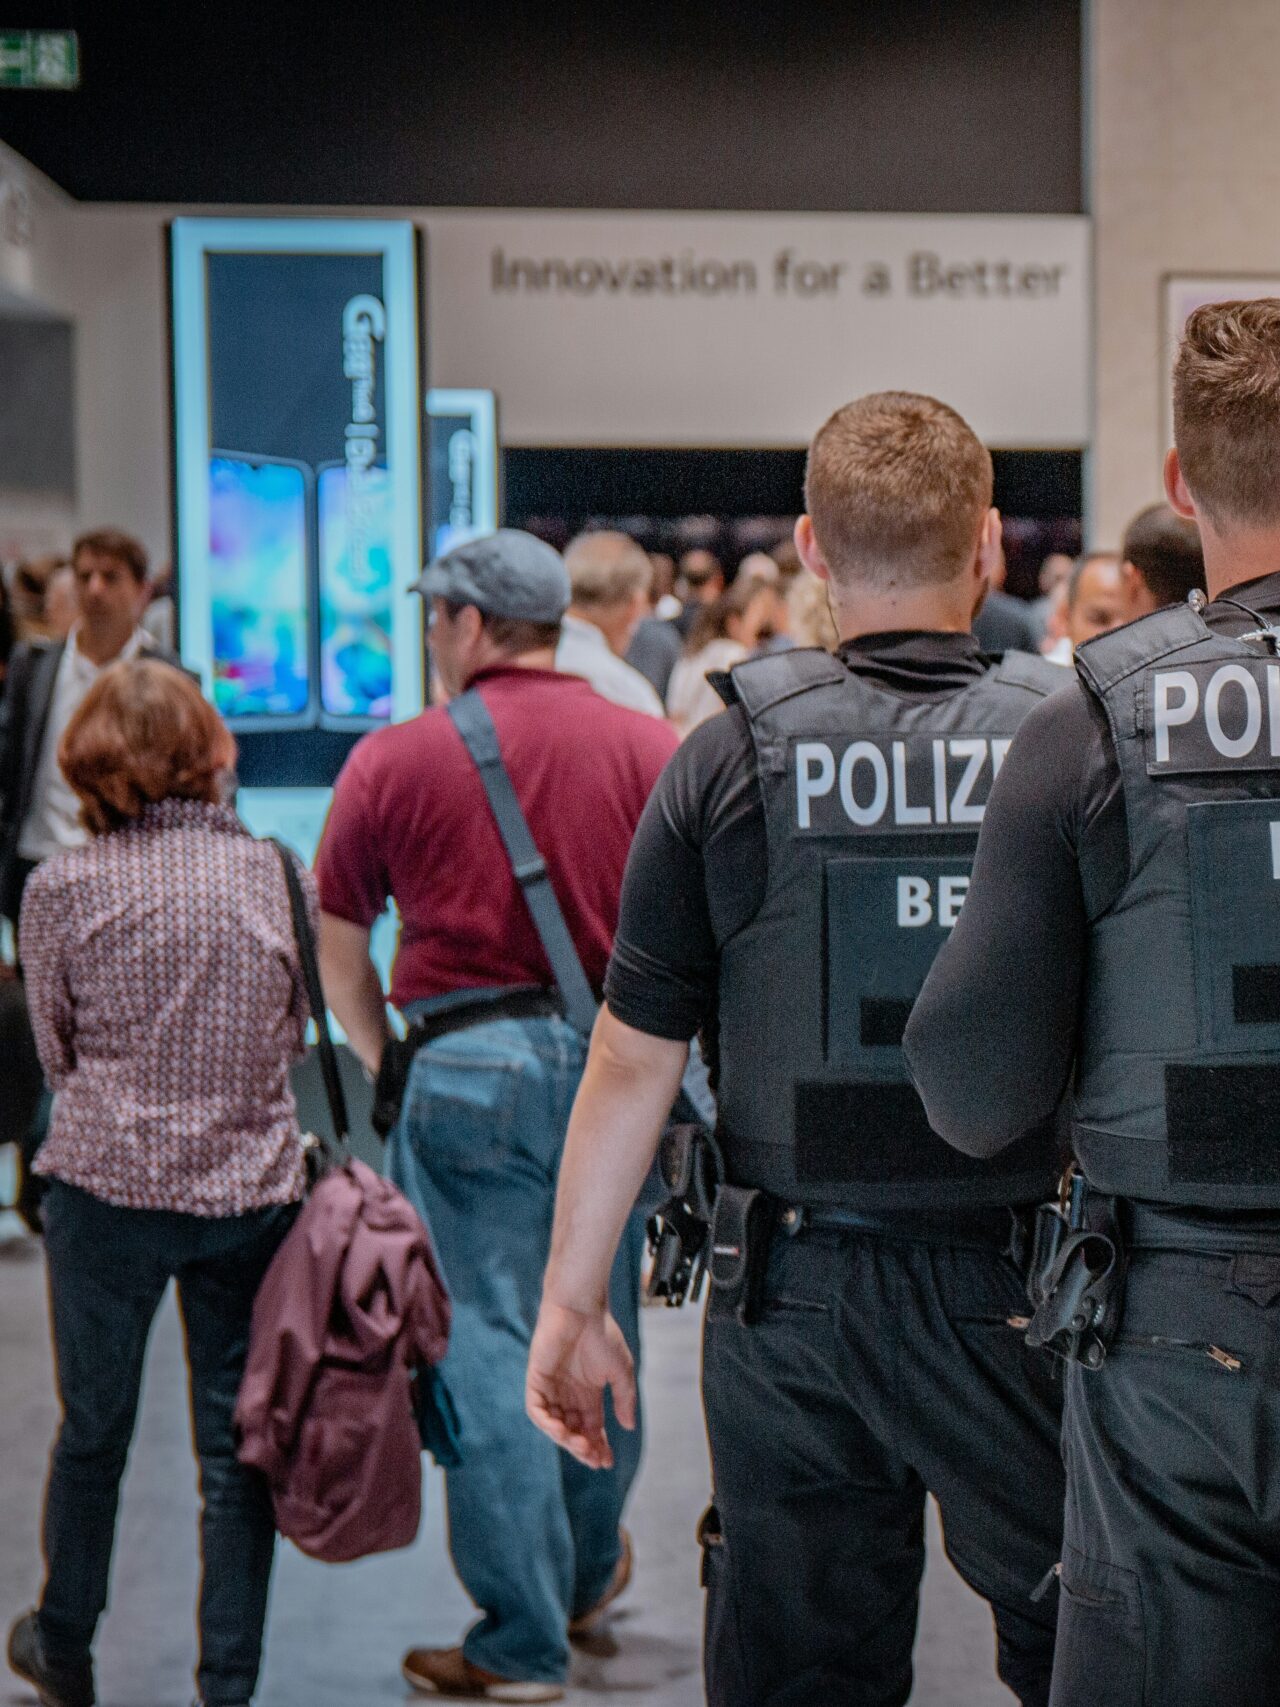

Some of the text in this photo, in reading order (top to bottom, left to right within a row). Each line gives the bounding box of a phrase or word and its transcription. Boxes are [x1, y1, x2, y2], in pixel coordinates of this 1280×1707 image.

[490, 247, 1066, 298] Innovation for a Better
[796, 739, 1012, 829] POLIZ
[897, 876, 970, 927] BE
